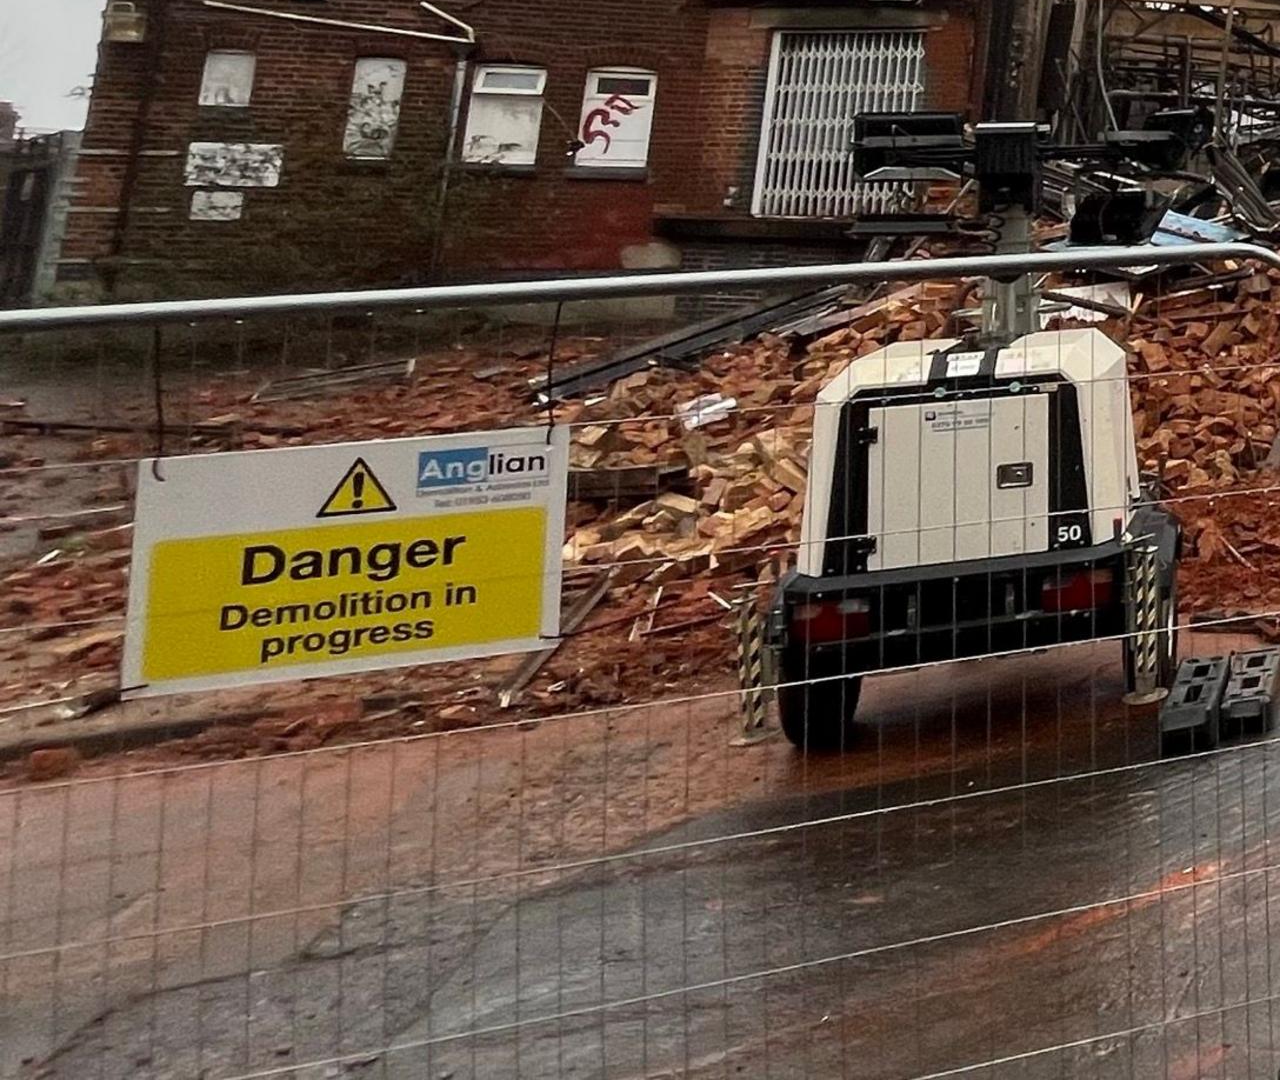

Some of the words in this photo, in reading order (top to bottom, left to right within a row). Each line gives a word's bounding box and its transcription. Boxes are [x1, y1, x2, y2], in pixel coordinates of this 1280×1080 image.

[420, 453, 545, 482] Anglian
[1058, 525, 1081, 542] 50
[241, 536, 466, 586] Danger
[219, 590, 432, 631] Demolition
[446, 582, 477, 606] in
[261, 620, 434, 663] progress
